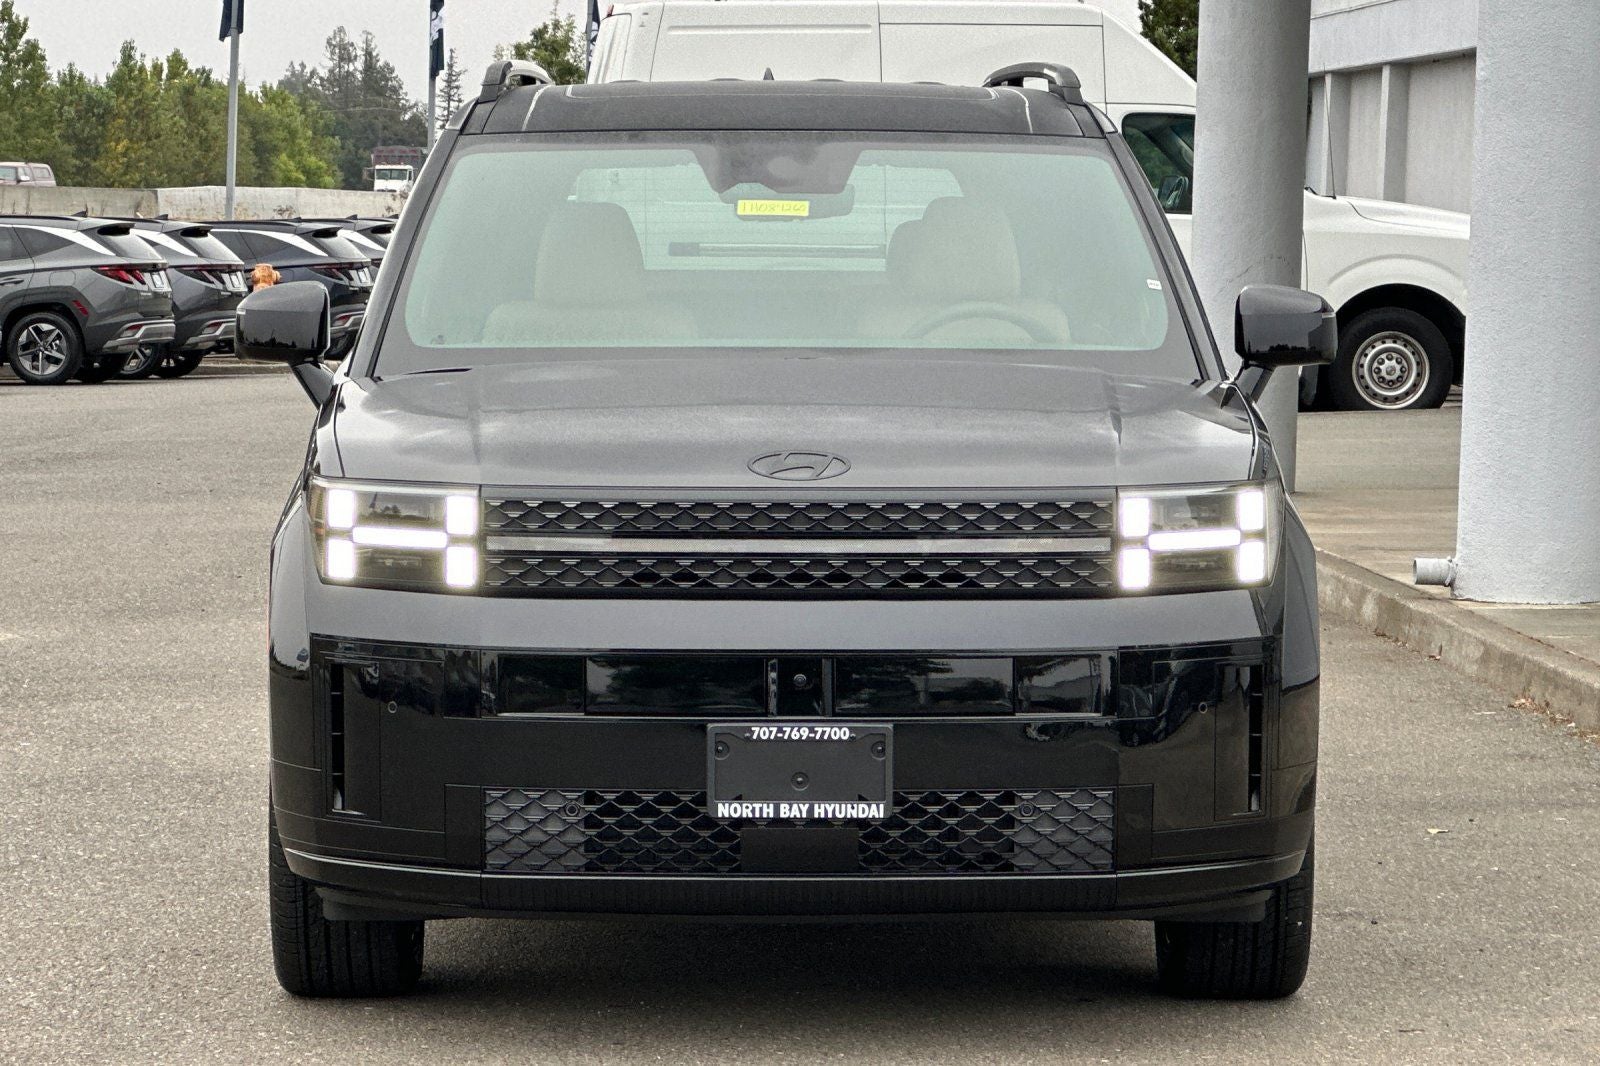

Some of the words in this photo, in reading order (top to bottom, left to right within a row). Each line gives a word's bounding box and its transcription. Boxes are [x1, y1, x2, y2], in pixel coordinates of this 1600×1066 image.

[751, 726, 850, 740] 707-769-7700
[717, 802, 774, 819] NORTH
[779, 802, 810, 819] BAY
[813, 802, 885, 819] HYUNDAI
